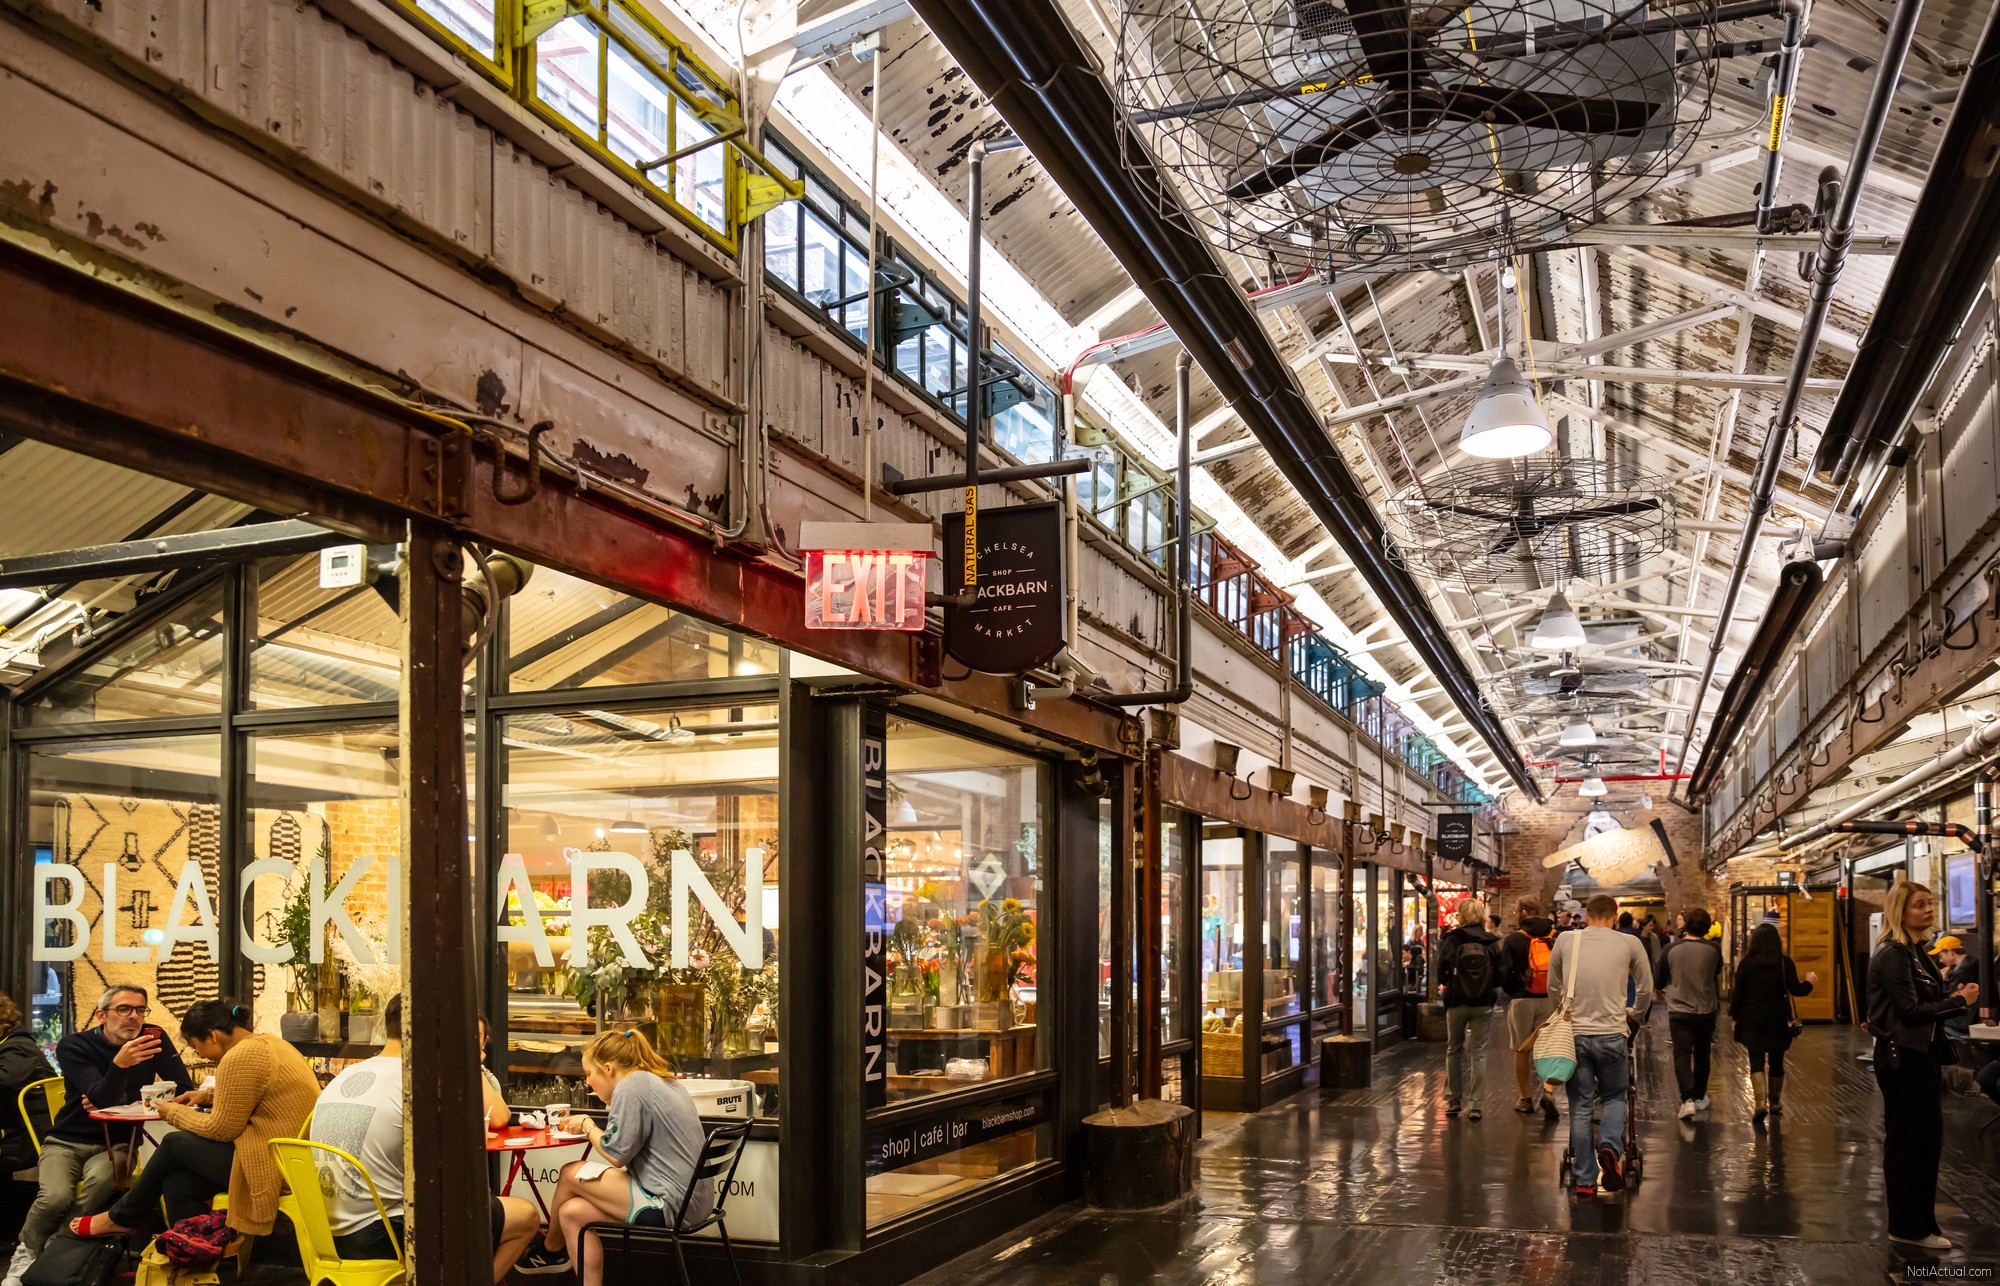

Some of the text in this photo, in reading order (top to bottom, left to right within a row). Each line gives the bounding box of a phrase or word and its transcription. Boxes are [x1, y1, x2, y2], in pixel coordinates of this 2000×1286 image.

[965, 488, 975, 583] NATURAL GAS
[976, 542, 1034, 560] CHELSEA
[992, 568, 1012, 577] SHOP
[822, 554, 913, 623] EXIT
[959, 580, 1048, 599] ACKBARN
[993, 604, 1012, 612] CAFE
[974, 618, 1033, 638] MARKET
[32, 848, 764, 968] BLACKARN
[717, 1095, 742, 1105] BRUTE
[882, 1120, 969, 1159] shop café bar
